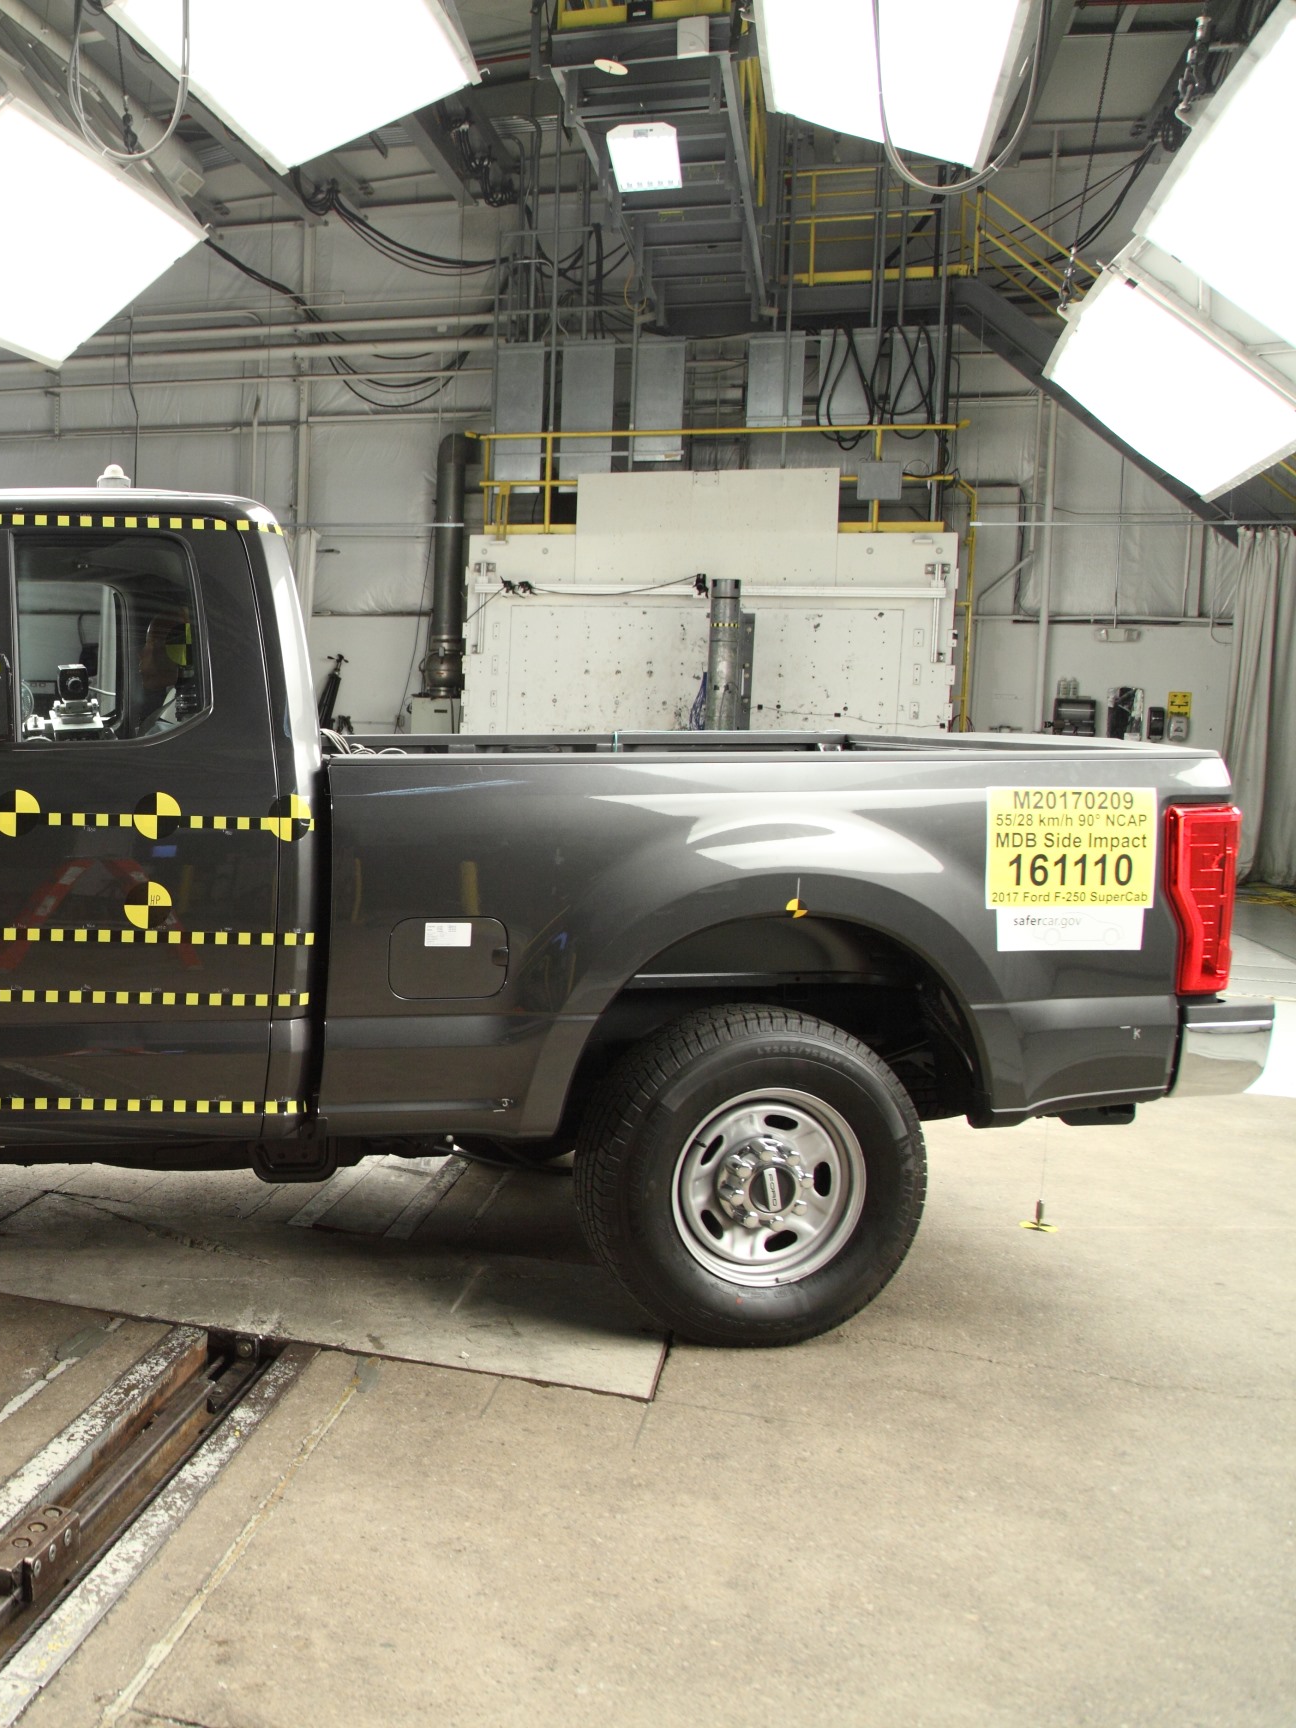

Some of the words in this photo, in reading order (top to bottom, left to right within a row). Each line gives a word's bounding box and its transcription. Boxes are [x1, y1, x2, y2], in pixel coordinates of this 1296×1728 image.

[1013, 791, 1135, 810] M20170209
[996, 813, 1034, 827] 55/28
[1039, 814, 1073, 827] km/h
[1078, 814, 1101, 827] 90°
[1106, 814, 1147, 827] NCAP
[996, 832, 1037, 848] MDB
[1044, 832, 1082, 848] Side
[1088, 832, 1147, 851] Impact
[1009, 853, 1133, 886] 161110
[150, 894, 161, 905] HP
[992, 892, 1019, 903] 2017
[1023, 892, 1050, 902] Ford
[1054, 892, 1086, 902] F-250
[1090, 892, 1148, 904] SuperCab
[1013, 915, 1083, 928] safercar.gov
[768, 1173, 778, 1207] FORD
